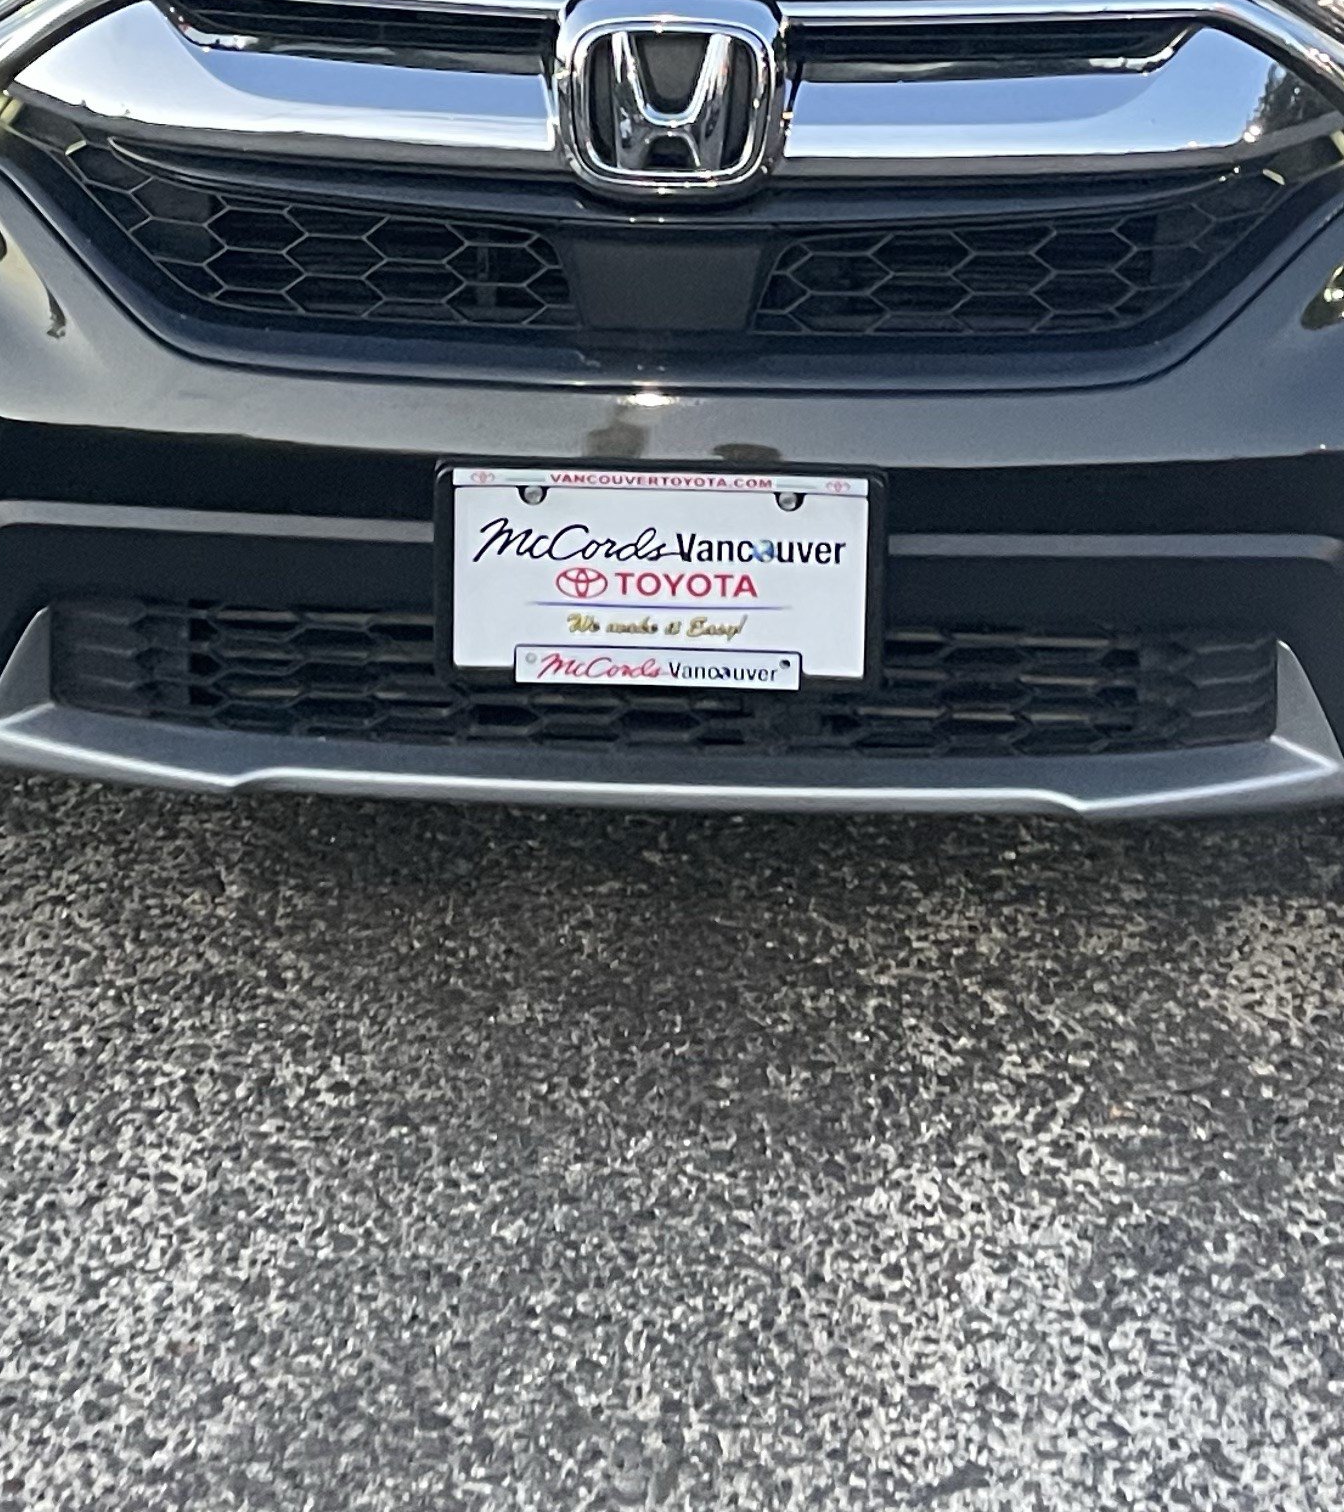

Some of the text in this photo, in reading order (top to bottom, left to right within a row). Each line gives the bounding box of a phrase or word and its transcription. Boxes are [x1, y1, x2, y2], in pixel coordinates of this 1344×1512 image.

[550, 473, 773, 489] VANCOUVERTOYOTA.COM
[473, 517, 847, 565] McCords Vancouver
[615, 571, 758, 598] TOYOTA
[537, 652, 778, 682] McCords Vancouver
